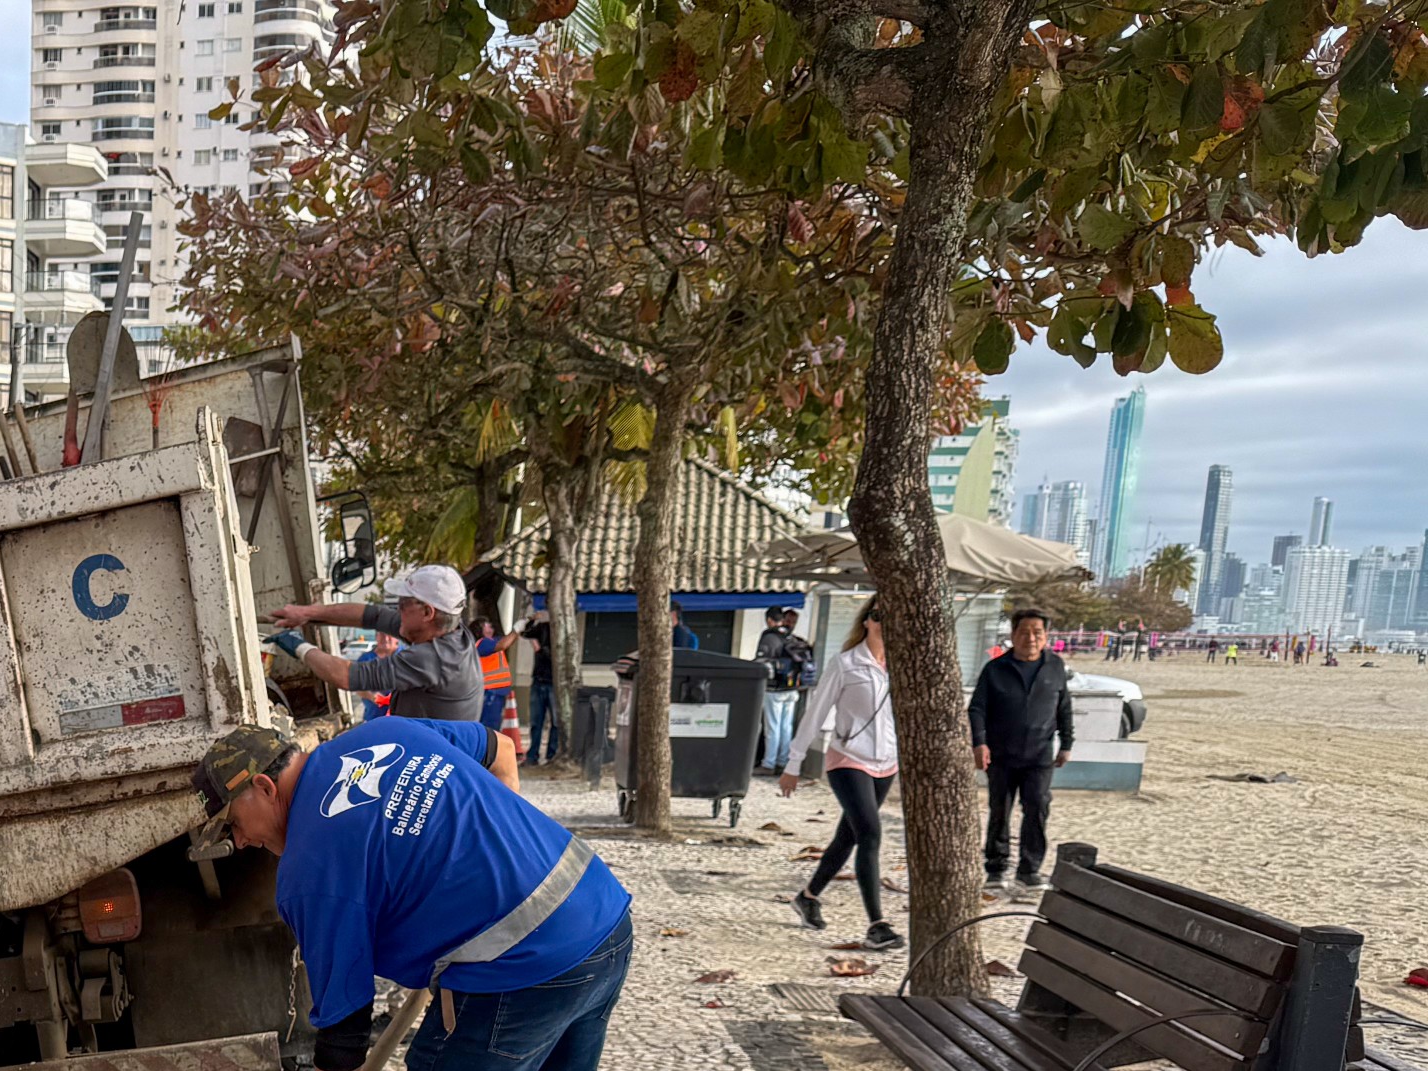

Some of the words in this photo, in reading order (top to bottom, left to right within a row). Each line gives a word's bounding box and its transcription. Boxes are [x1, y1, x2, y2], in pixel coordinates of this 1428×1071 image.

[72, 554, 130, 621] C
[384, 756, 424, 820] PREFEITURA
[392, 784, 423, 837] Balneário
[414, 753, 444, 784] Camboriú
[431, 777, 445, 789] de
[436, 763, 455, 779] Obras
[408, 788, 438, 836] Secretaria
